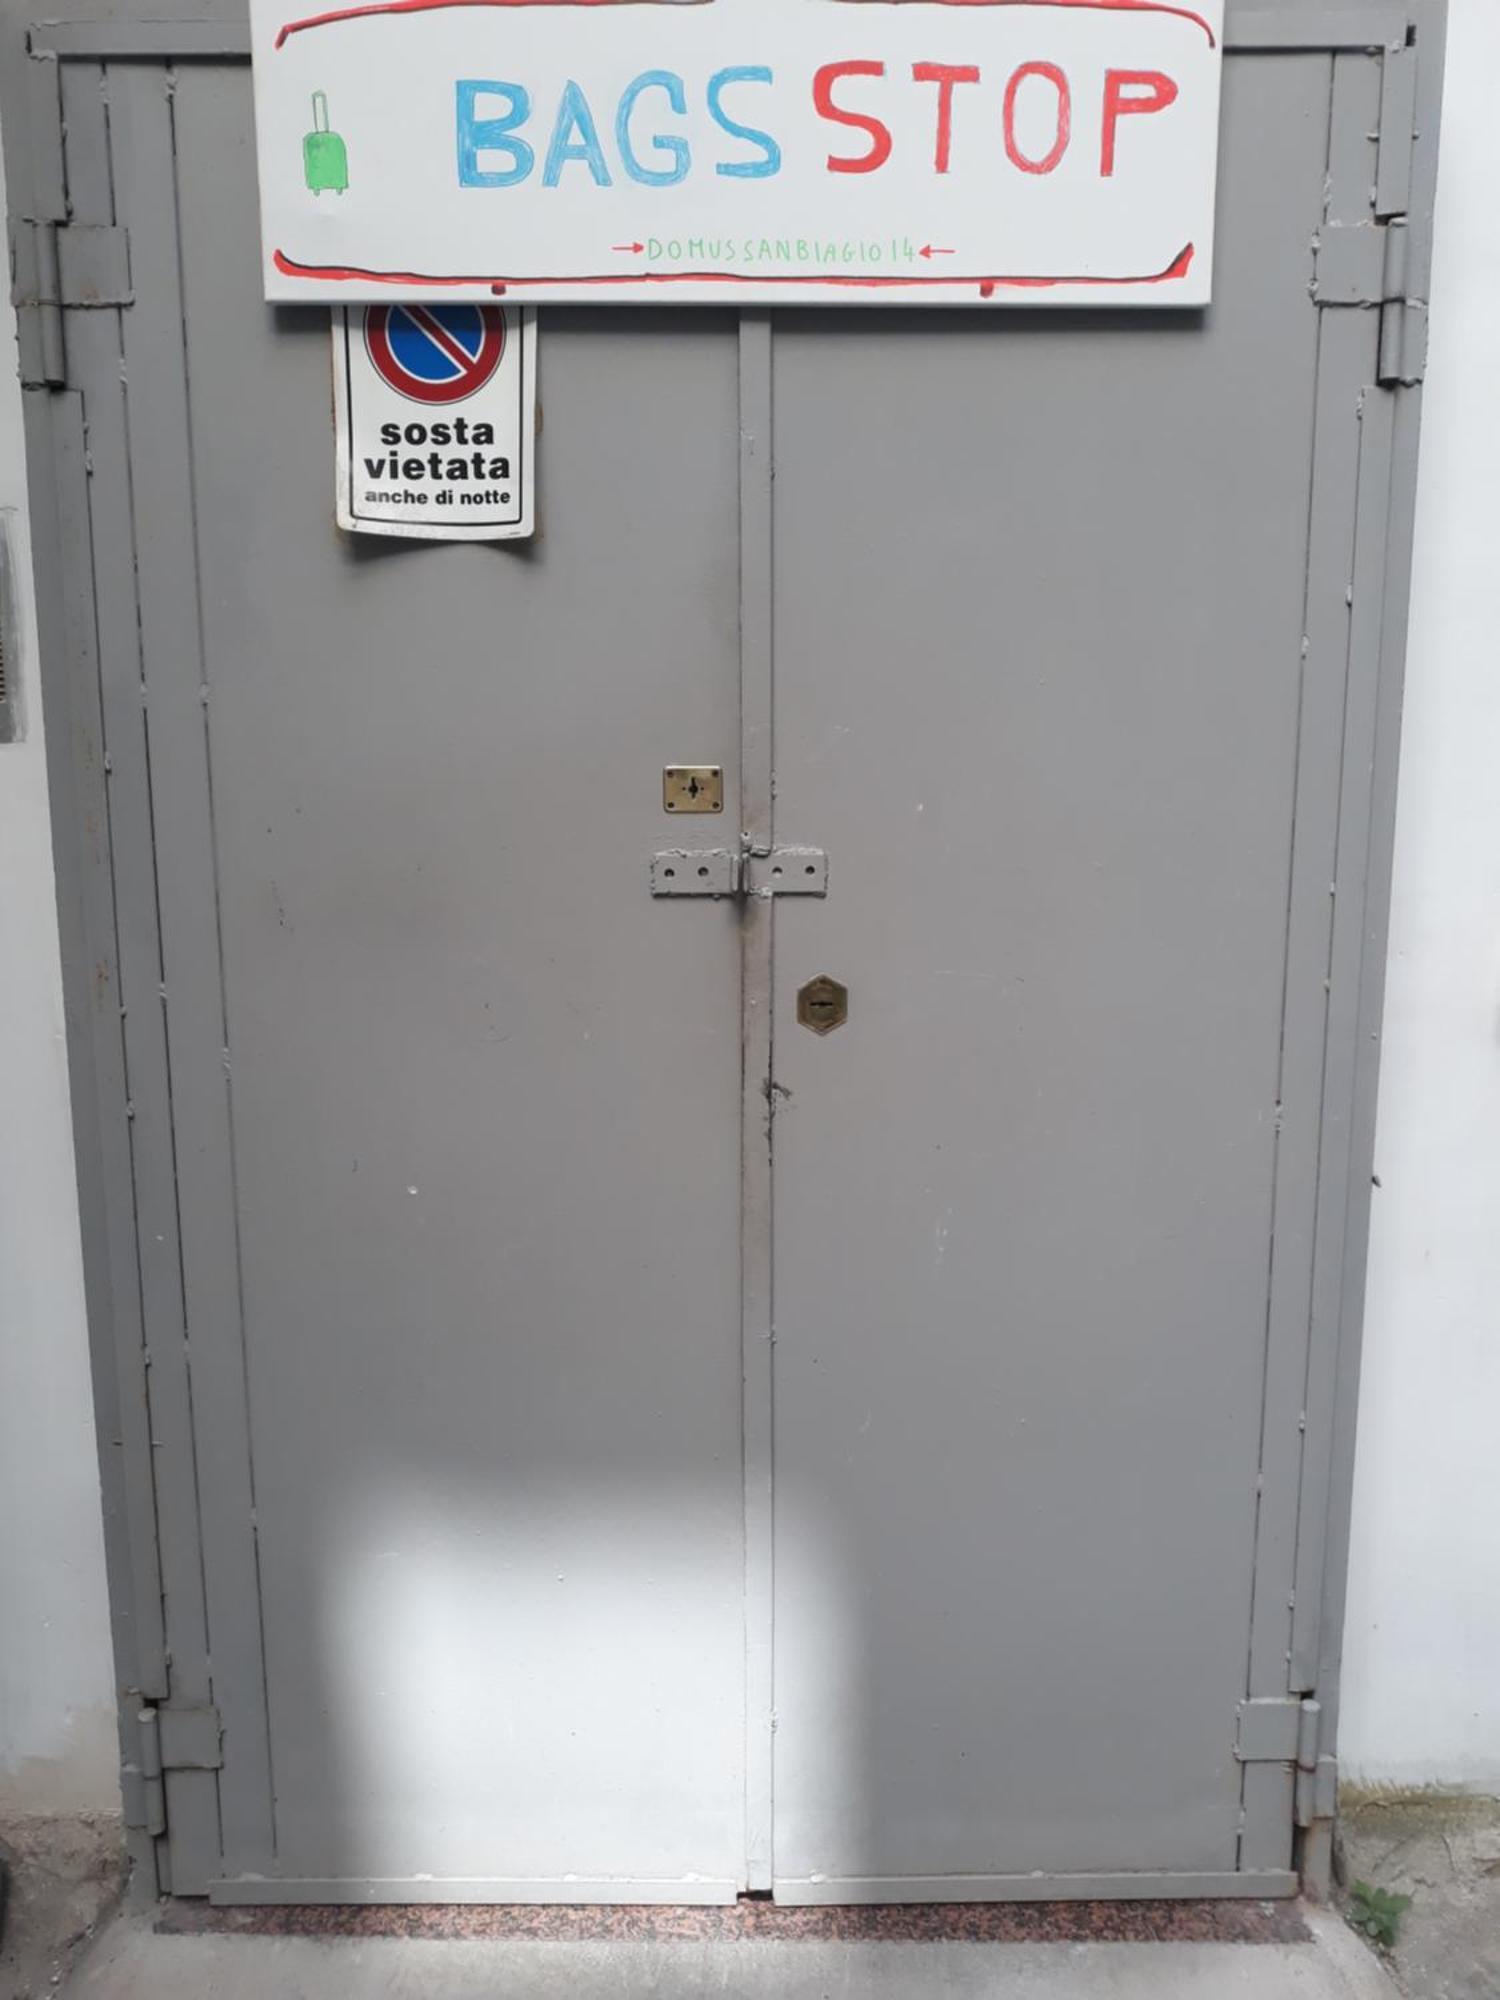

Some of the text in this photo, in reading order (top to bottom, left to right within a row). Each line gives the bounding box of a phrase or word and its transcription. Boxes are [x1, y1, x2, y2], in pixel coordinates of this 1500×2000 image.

[455, 60, 1178, 189] BAGS STOP
[380, 417, 494, 446] sosta
[364, 450, 510, 480] vietata
[364, 489, 511, 505] anche di notte
